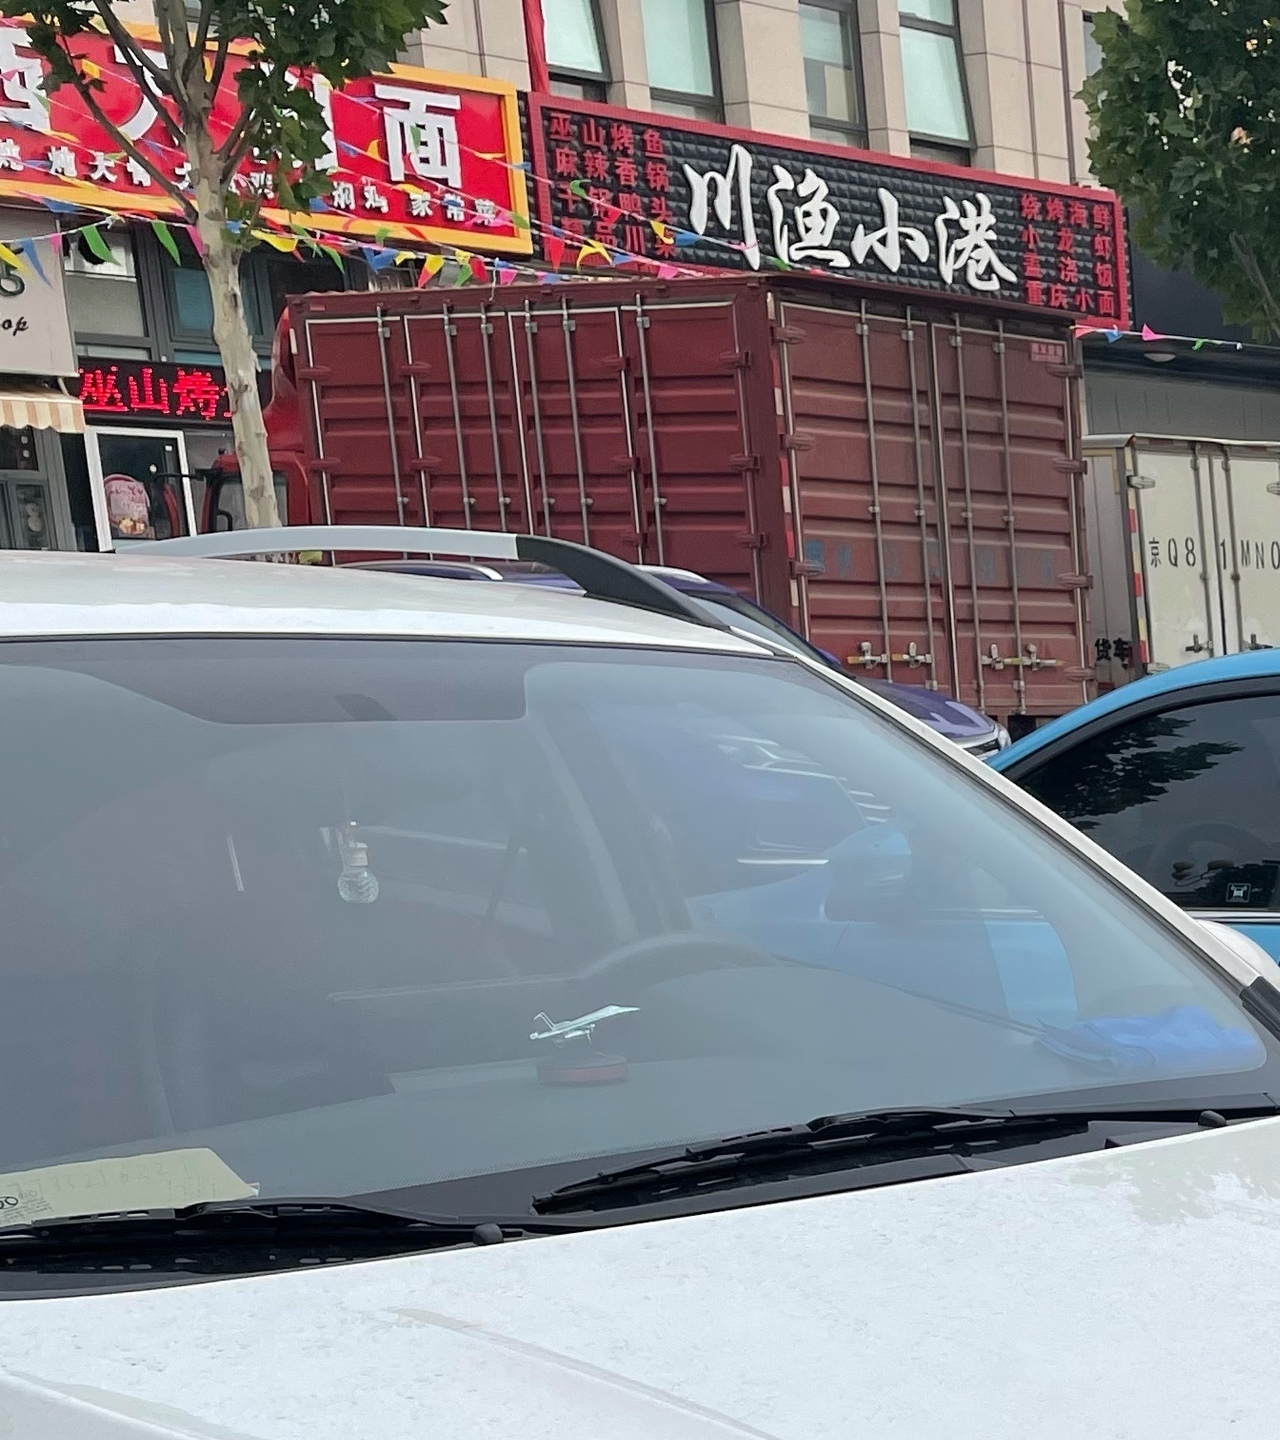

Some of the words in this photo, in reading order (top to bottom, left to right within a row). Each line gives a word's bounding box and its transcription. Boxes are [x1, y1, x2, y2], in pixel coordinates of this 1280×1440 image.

[550, 112, 665, 158] 巫山烤鱼
[555, 147, 670, 193] 麻辣香锅
[683, 143, 1017, 291] 川渔小港
[1021, 193, 1112, 232] 烧烤海鲜
[1022, 224, 1112, 261] 小龙虾
[1023, 252, 1114, 288] 盖浇饭
[1025, 281, 1115, 317] 重庆小面
[79, 364, 233, 422] 巫山烤
